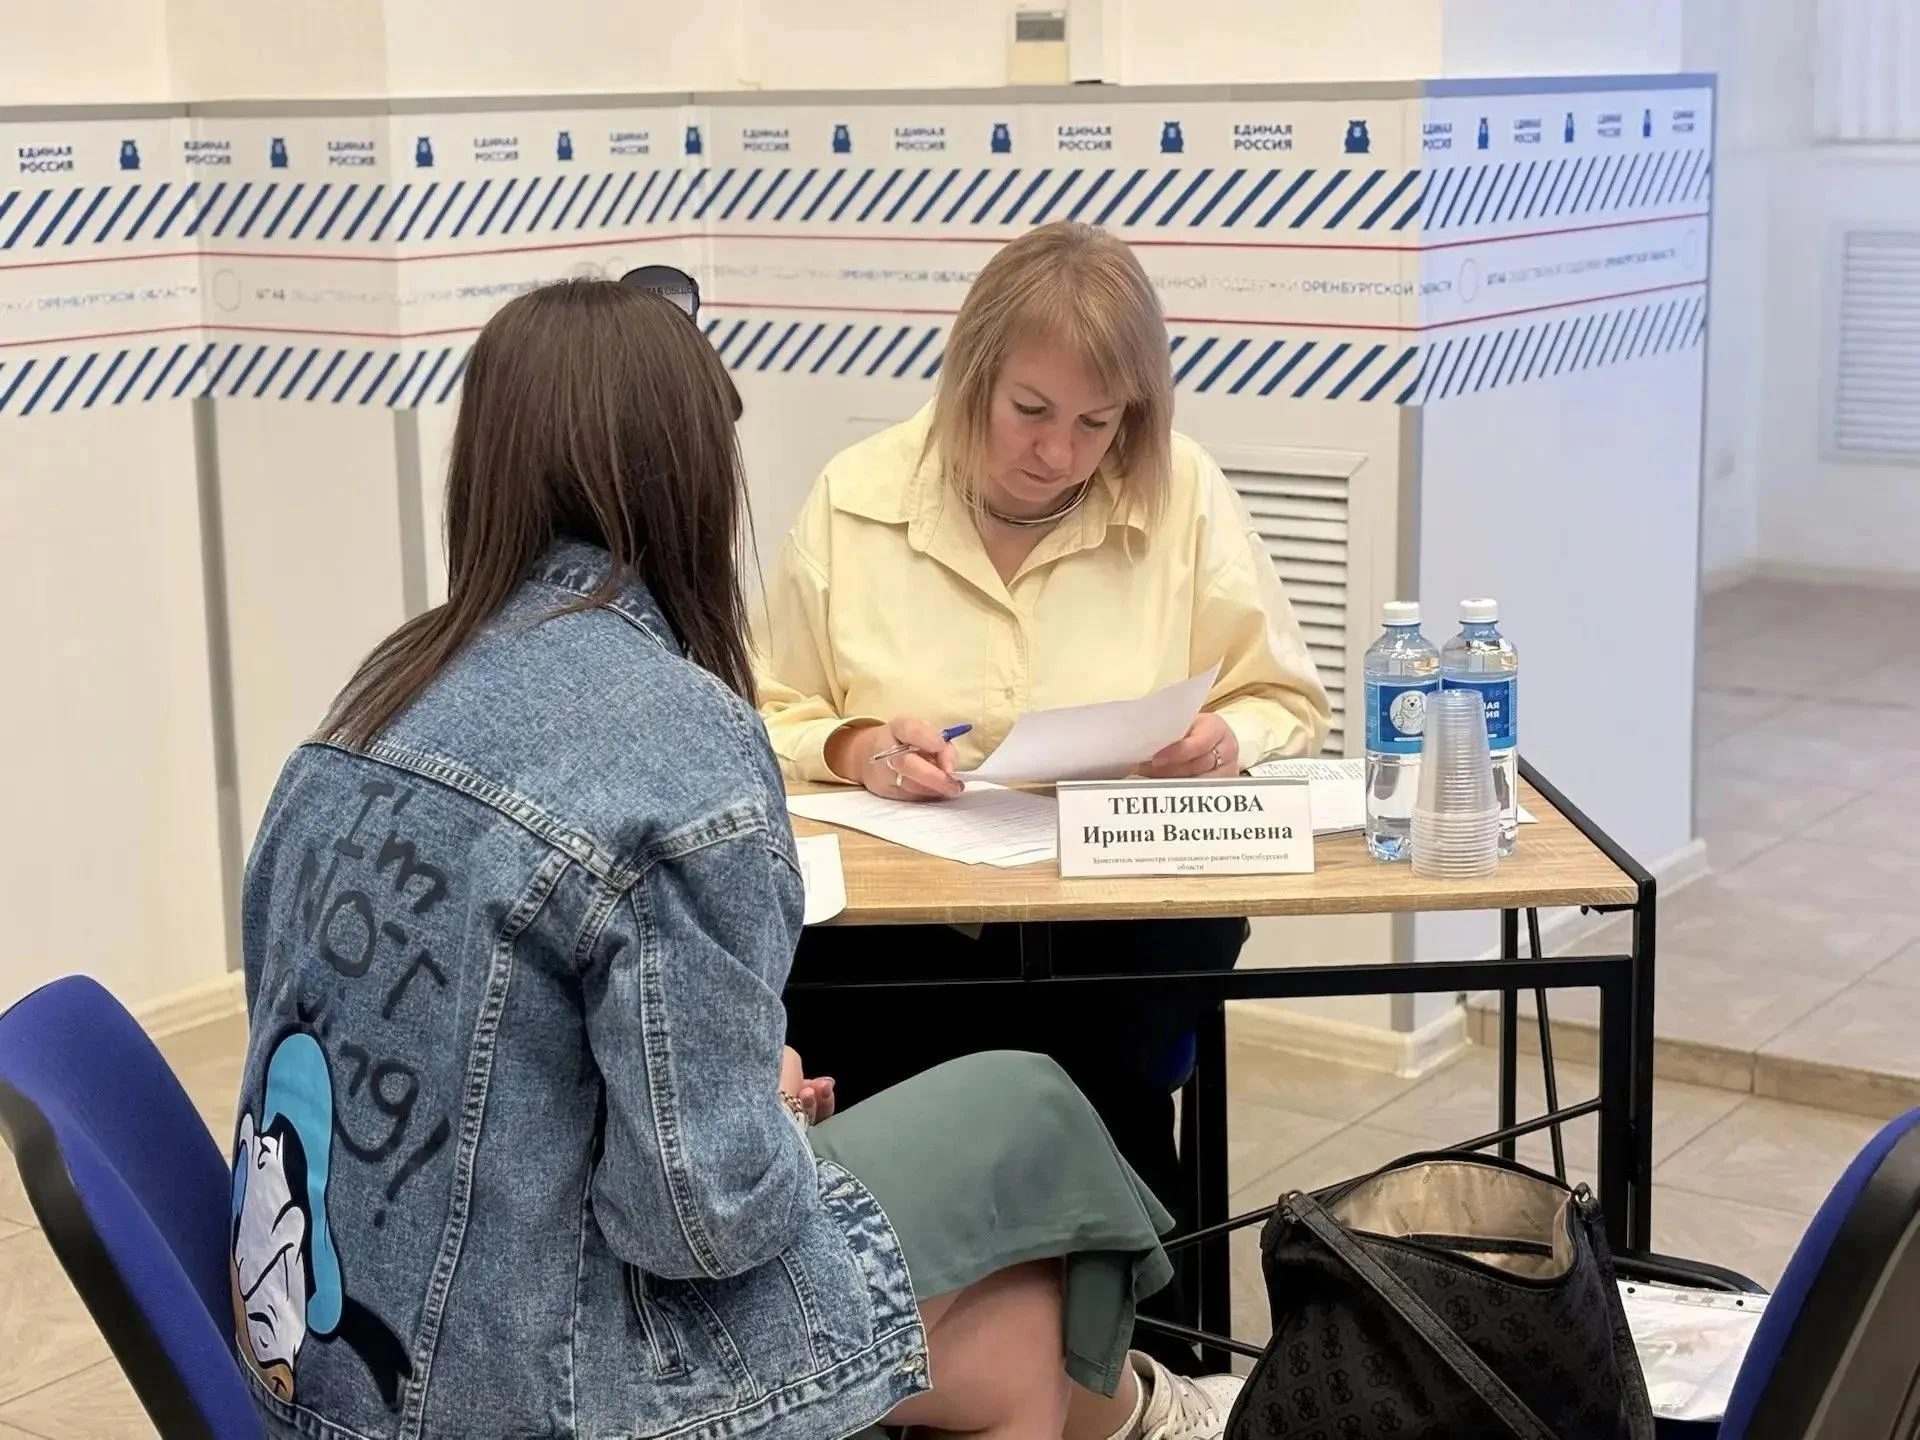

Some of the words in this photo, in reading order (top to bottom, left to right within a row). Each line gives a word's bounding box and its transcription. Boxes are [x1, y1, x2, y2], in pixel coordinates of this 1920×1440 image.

[895, 127, 944, 137] ЕДИНАЯ
[1058, 126, 1112, 136] ЕДИНАЯ
[1233, 124, 1292, 135] ЕДИНАЯ
[896, 141, 945, 150] РОССИЯ
[1058, 140, 1112, 150] РОССИЯ
[1233, 139, 1292, 150] РОССИЯ
[19, 146, 73, 159] ЕДИНАЯ
[20, 160, 73, 172] РОССИЯ
[1302, 280, 1414, 296] ОРЕНБУРГСКОЙ
[1108, 794, 1264, 816] ТЕПЛЯКОВА
[1083, 825, 1155, 848] Ирина
[1163, 823, 1293, 842] Васильевна
[333, 780, 448, 913] I'm
